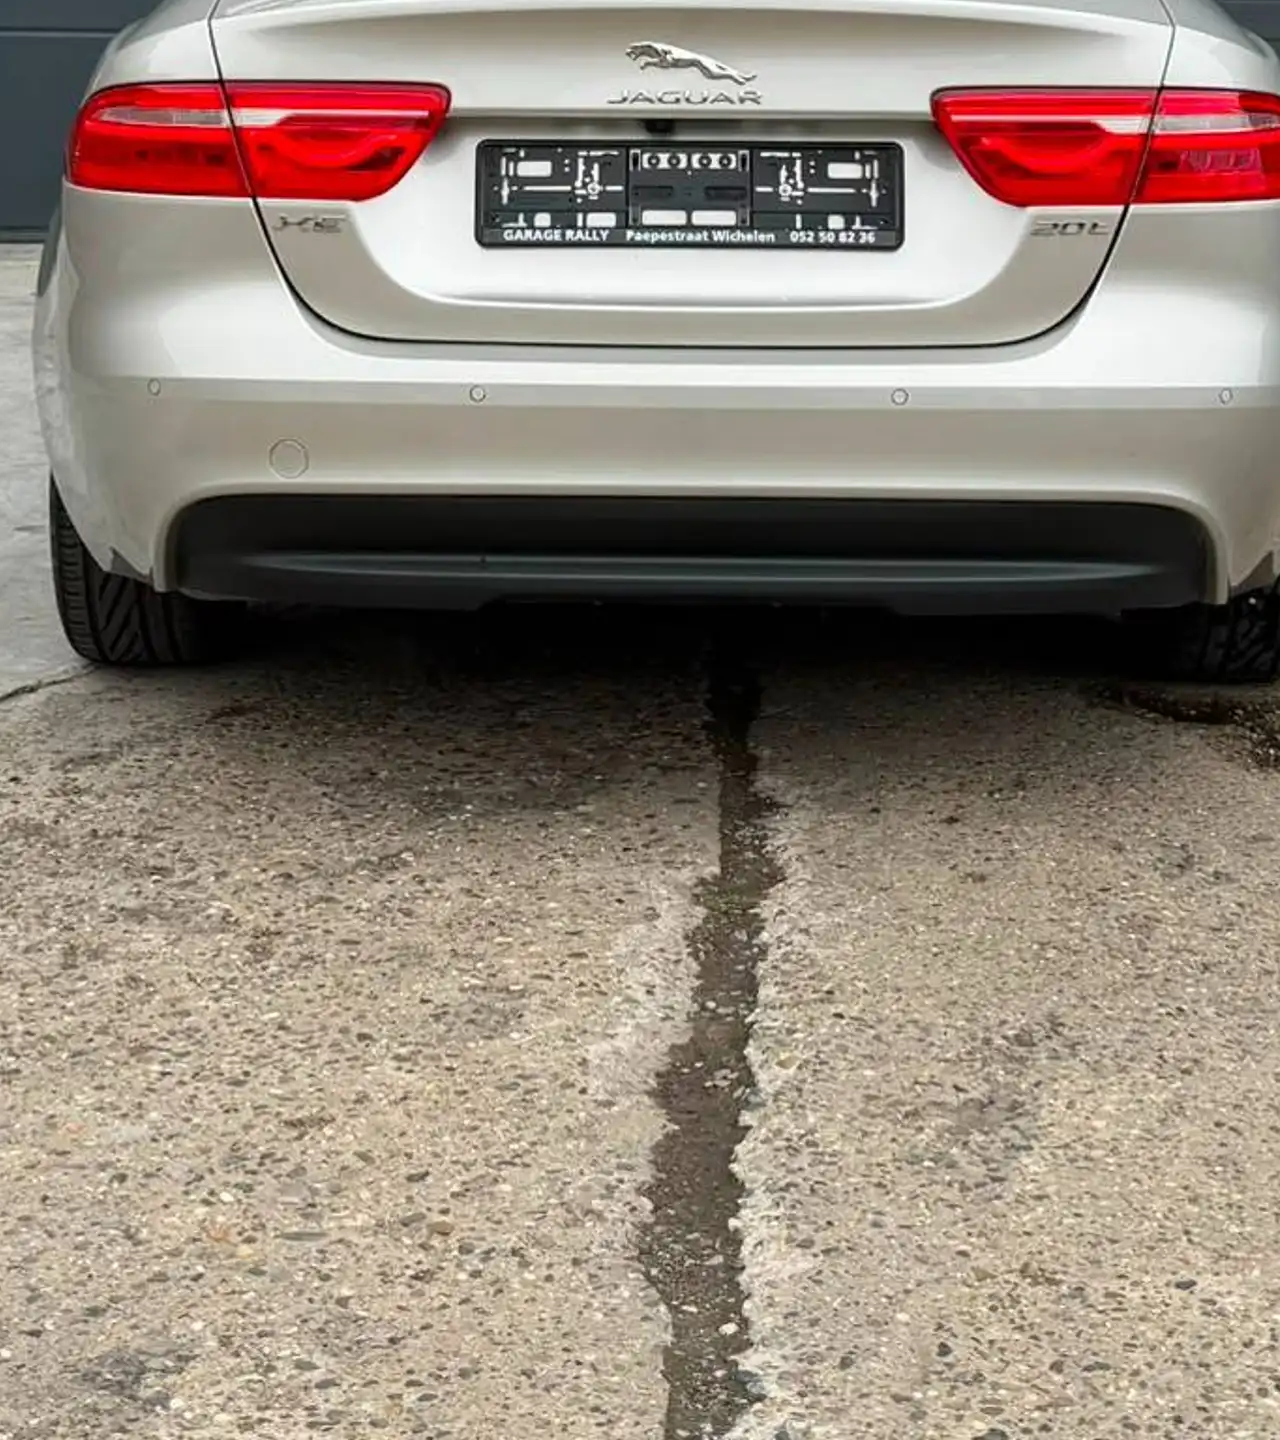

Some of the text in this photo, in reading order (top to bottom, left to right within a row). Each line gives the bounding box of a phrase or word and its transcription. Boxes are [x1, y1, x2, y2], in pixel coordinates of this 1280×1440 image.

[606, 90, 764, 106] JAGUAR
[503, 228, 561, 242] GARAGE
[565, 229, 610, 242] RALLY
[625, 229, 709, 244] Paepestraat
[712, 230, 776, 243] Wichelen
